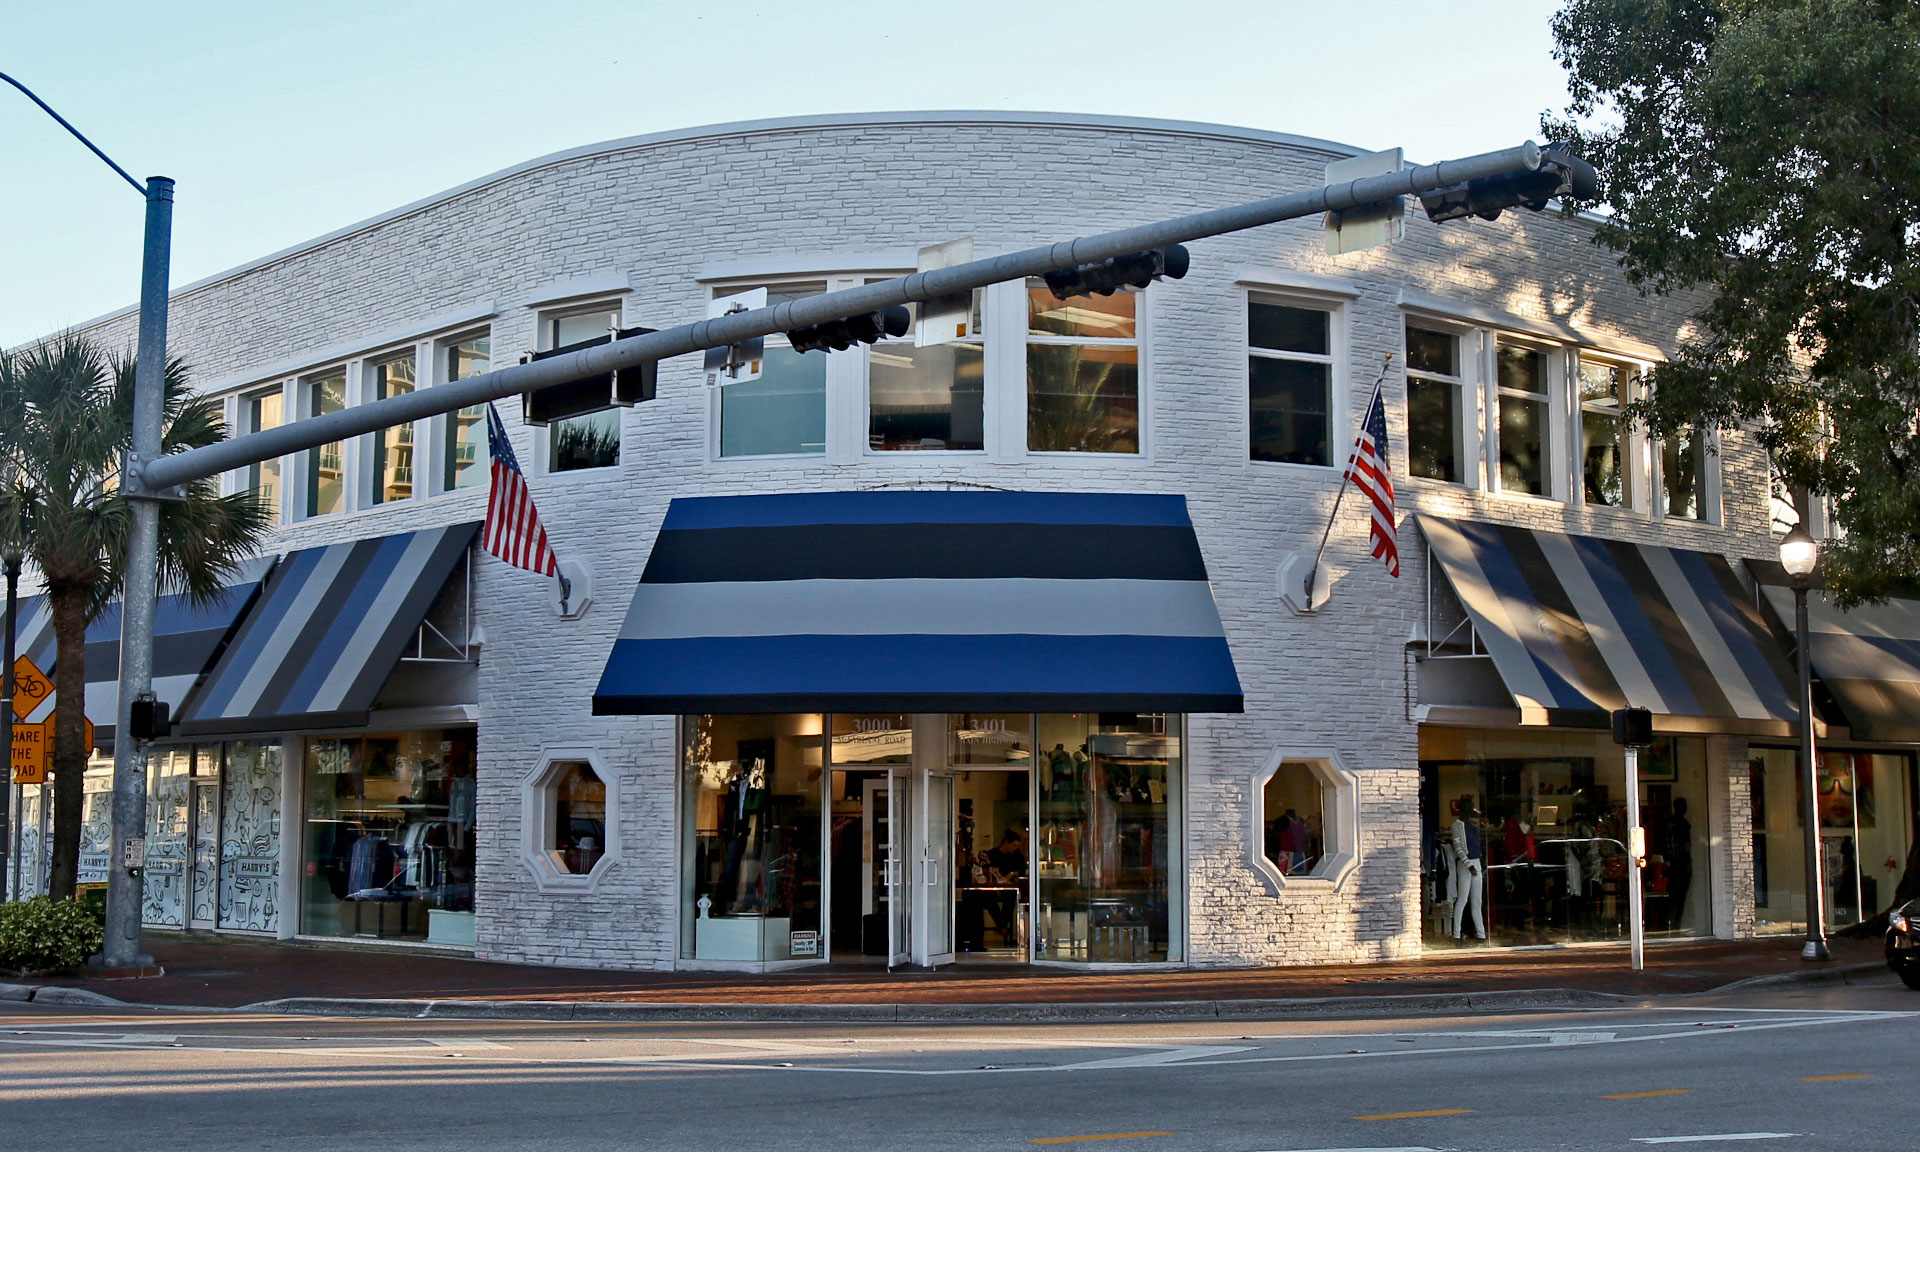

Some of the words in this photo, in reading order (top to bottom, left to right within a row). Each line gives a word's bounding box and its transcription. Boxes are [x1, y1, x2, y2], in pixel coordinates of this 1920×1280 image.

[853, 718, 891, 733] 3000
[970, 718, 1006, 733] 3401
[12, 731, 40, 742] HARE
[884, 736, 906, 745] ROAD
[12, 748, 31, 759] THE
[14, 765, 35, 776] OAD
[83, 858, 107, 867] HARRY'S
[241, 862, 270, 872] HARRY'S
